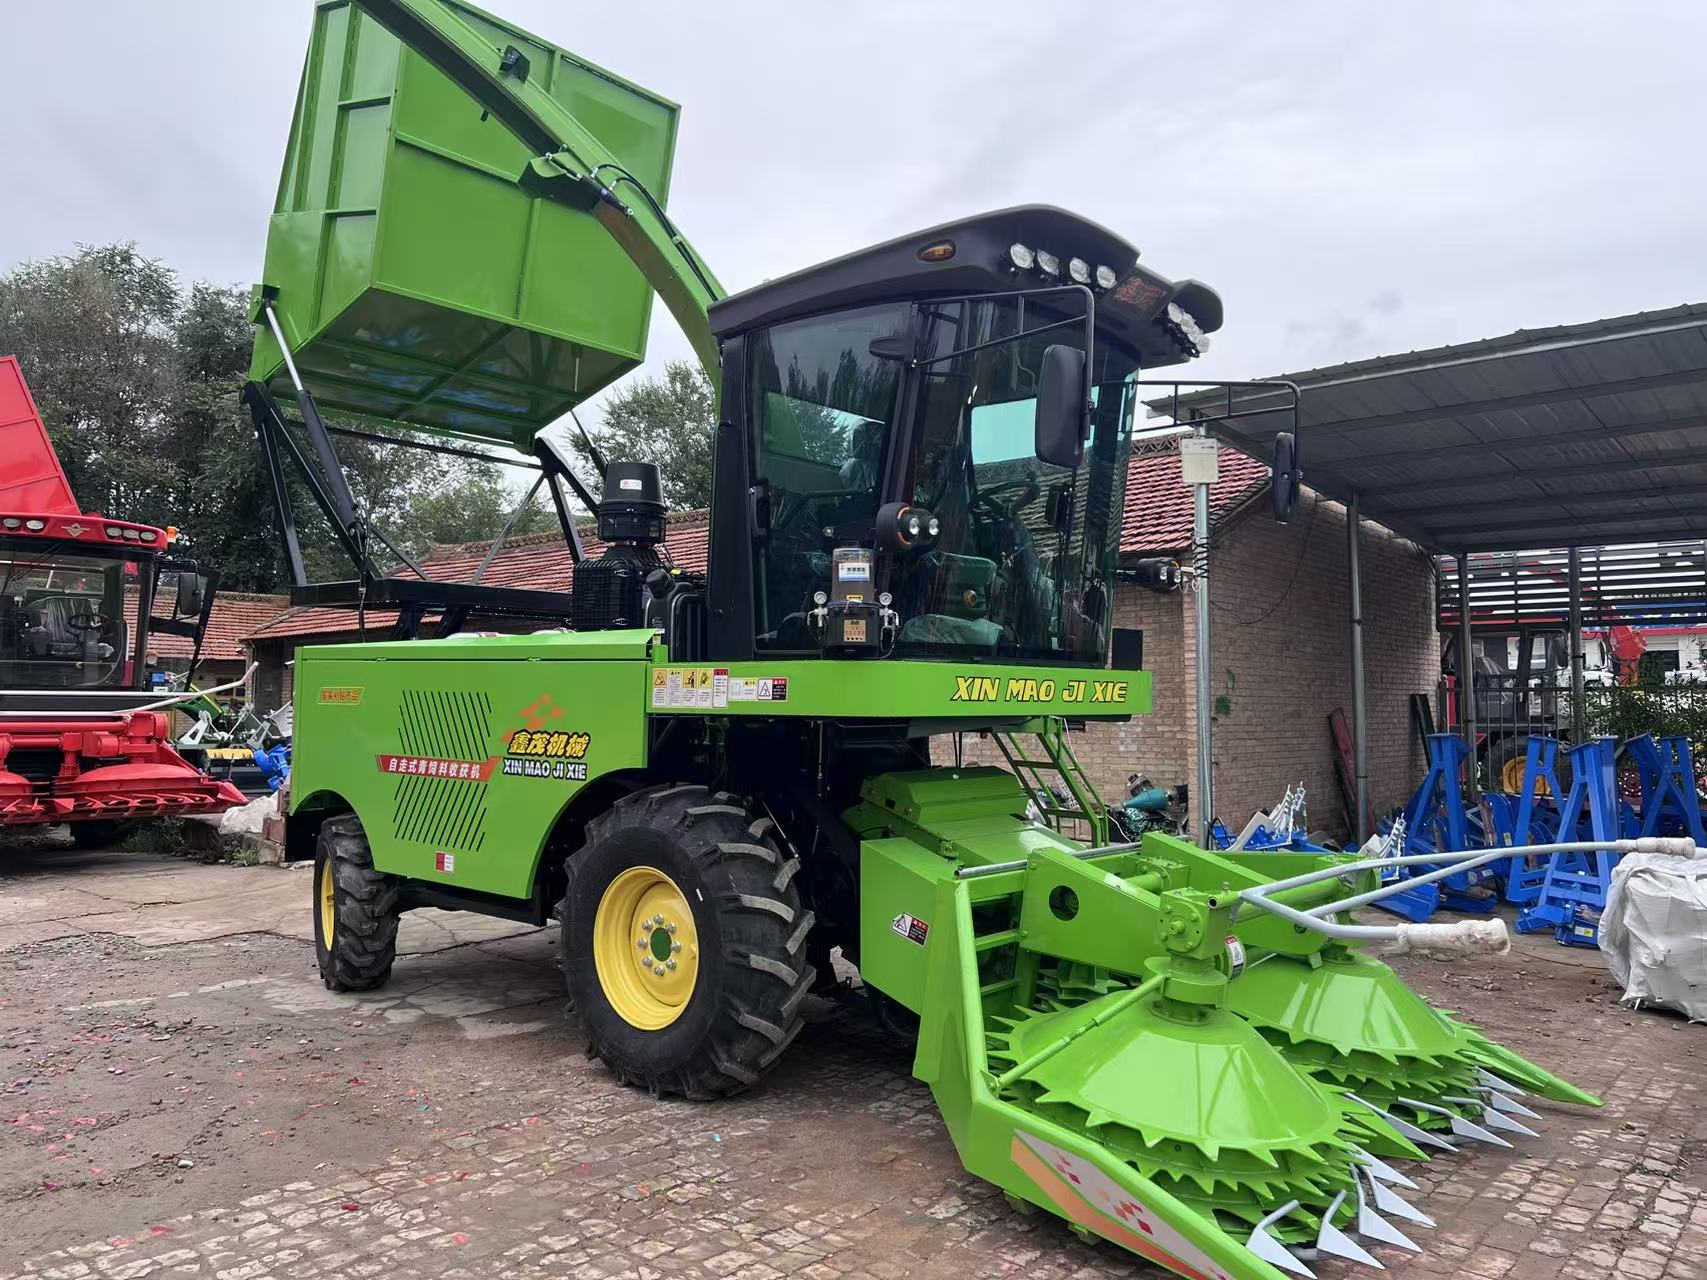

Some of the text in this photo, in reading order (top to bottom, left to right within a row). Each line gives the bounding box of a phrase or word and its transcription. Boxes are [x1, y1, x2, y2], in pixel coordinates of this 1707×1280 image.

[951, 676, 1128, 703] XIN MAO JI XIE
[508, 730, 590, 758] 鑫茂机械
[389, 757, 480, 779] 自走式青饲料收获机
[503, 758, 587, 780] XIN MAO JI XIE
